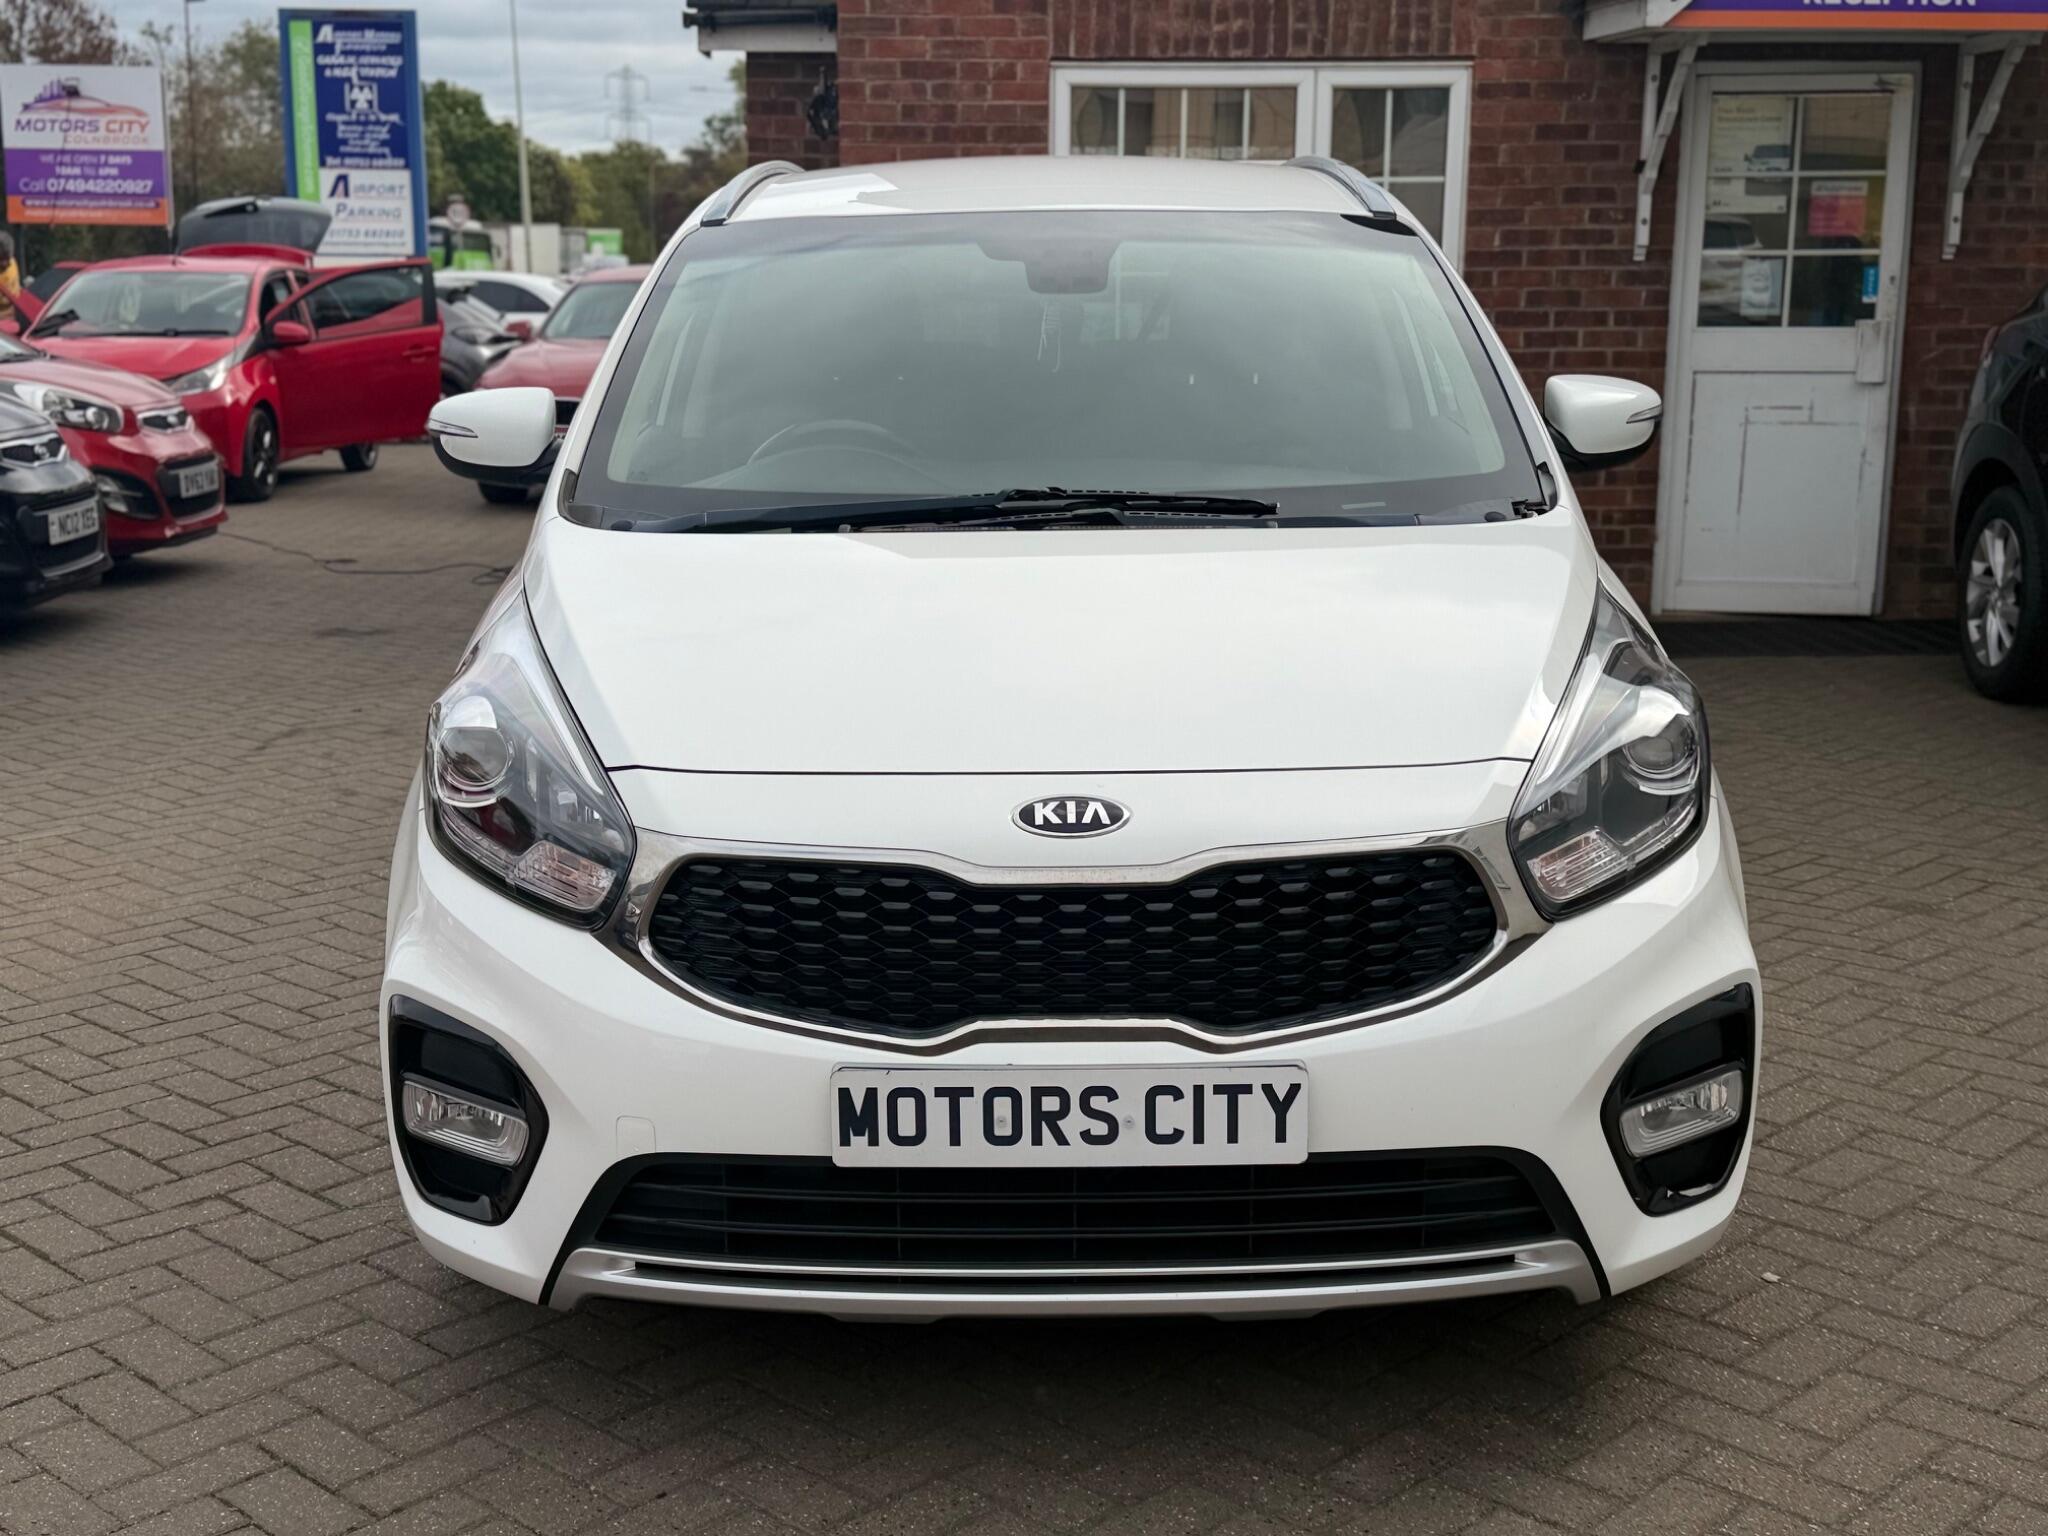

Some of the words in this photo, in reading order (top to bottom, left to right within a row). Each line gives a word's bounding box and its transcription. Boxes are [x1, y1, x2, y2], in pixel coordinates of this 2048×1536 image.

[14, 118, 100, 133] MOTORS
[105, 118, 150, 133] CITY
[18, 178, 45, 191] Call
[1033, 801, 1112, 826] KIA
[838, 1085, 1119, 1148] MOTORS
[1144, 1083, 1302, 1145] CITY
